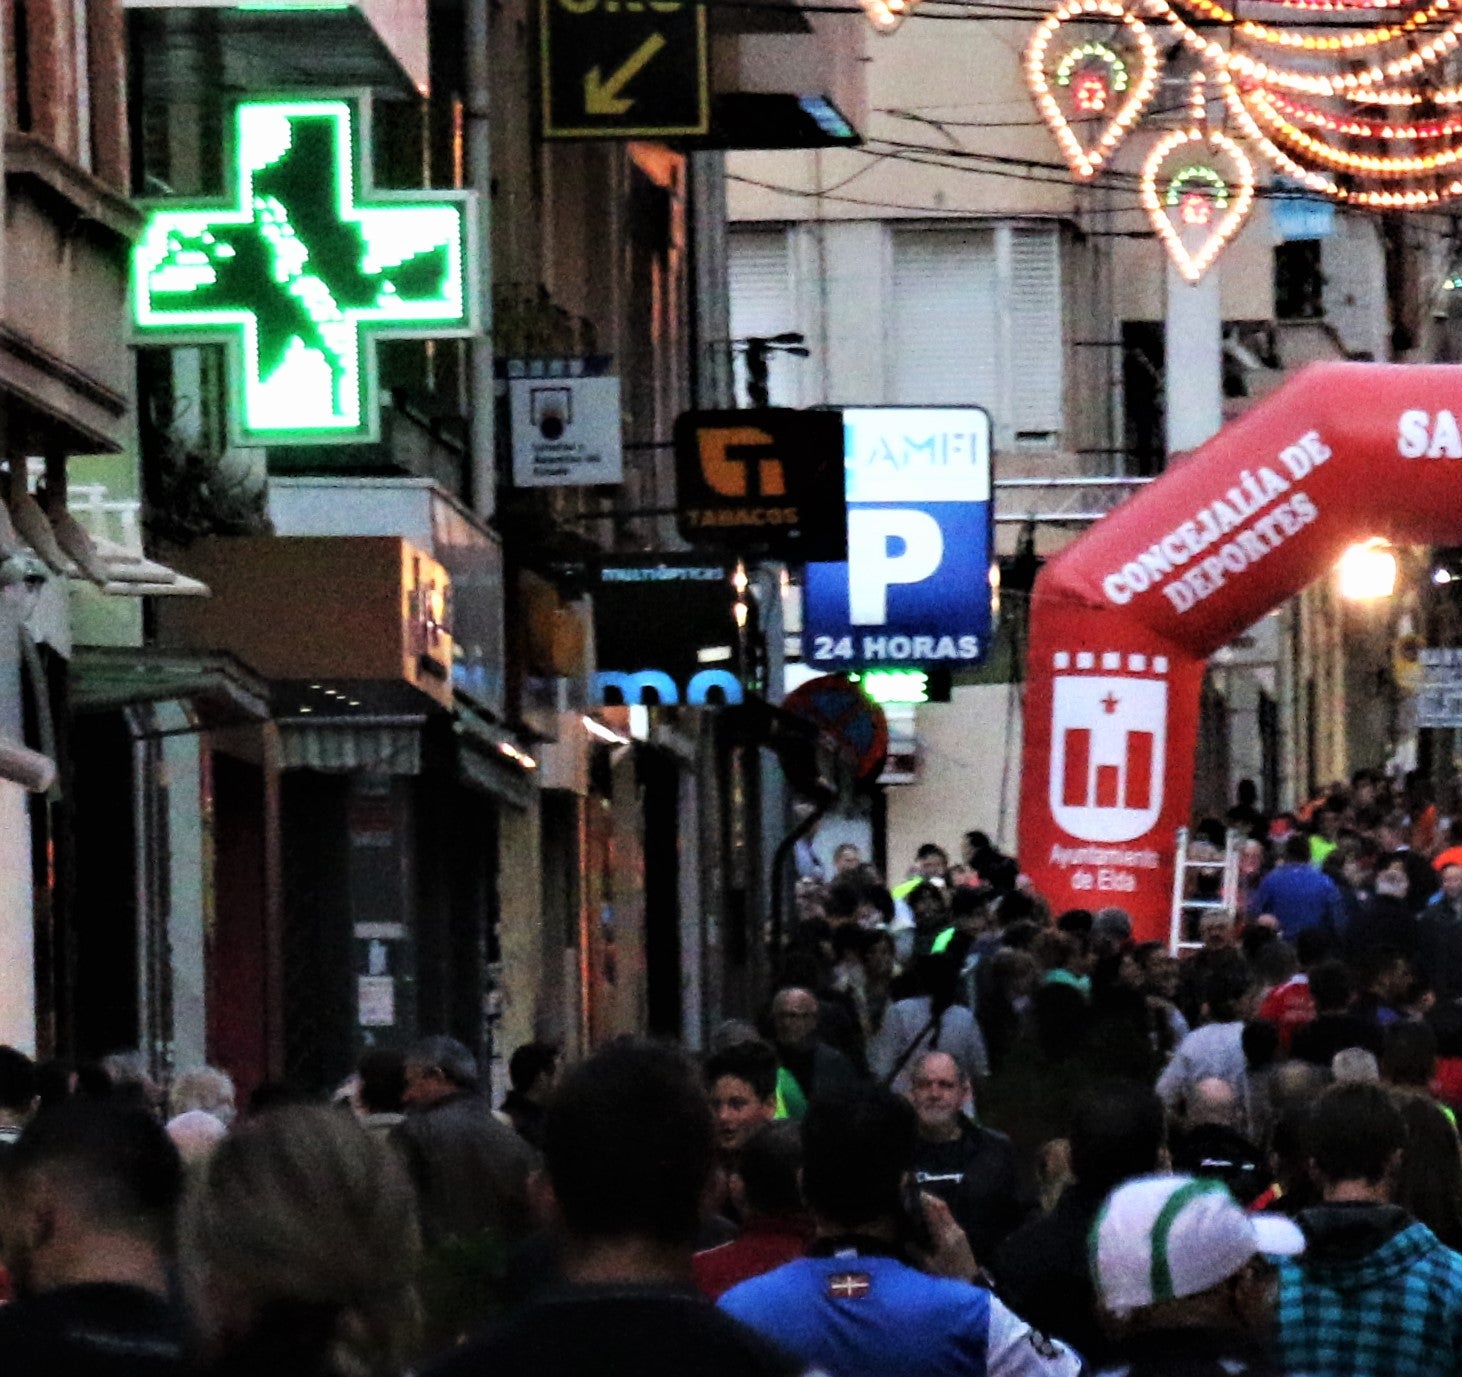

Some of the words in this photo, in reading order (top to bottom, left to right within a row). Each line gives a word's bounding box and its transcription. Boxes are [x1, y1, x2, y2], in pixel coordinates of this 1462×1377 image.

[684, 507, 799, 526] TABACOS
[1102, 467, 1292, 606] CONCEJALÍA
[1278, 431, 1334, 481] DE
[1162, 491, 1319, 614] DEPORTES
[848, 508, 944, 626] P
[813, 635, 853, 661] 24
[861, 634, 980, 660] HORAS
[1050, 844, 1160, 868] Ayuntamiento
[1071, 870, 1094, 891] de
[1098, 868, 1137, 892] Elda
